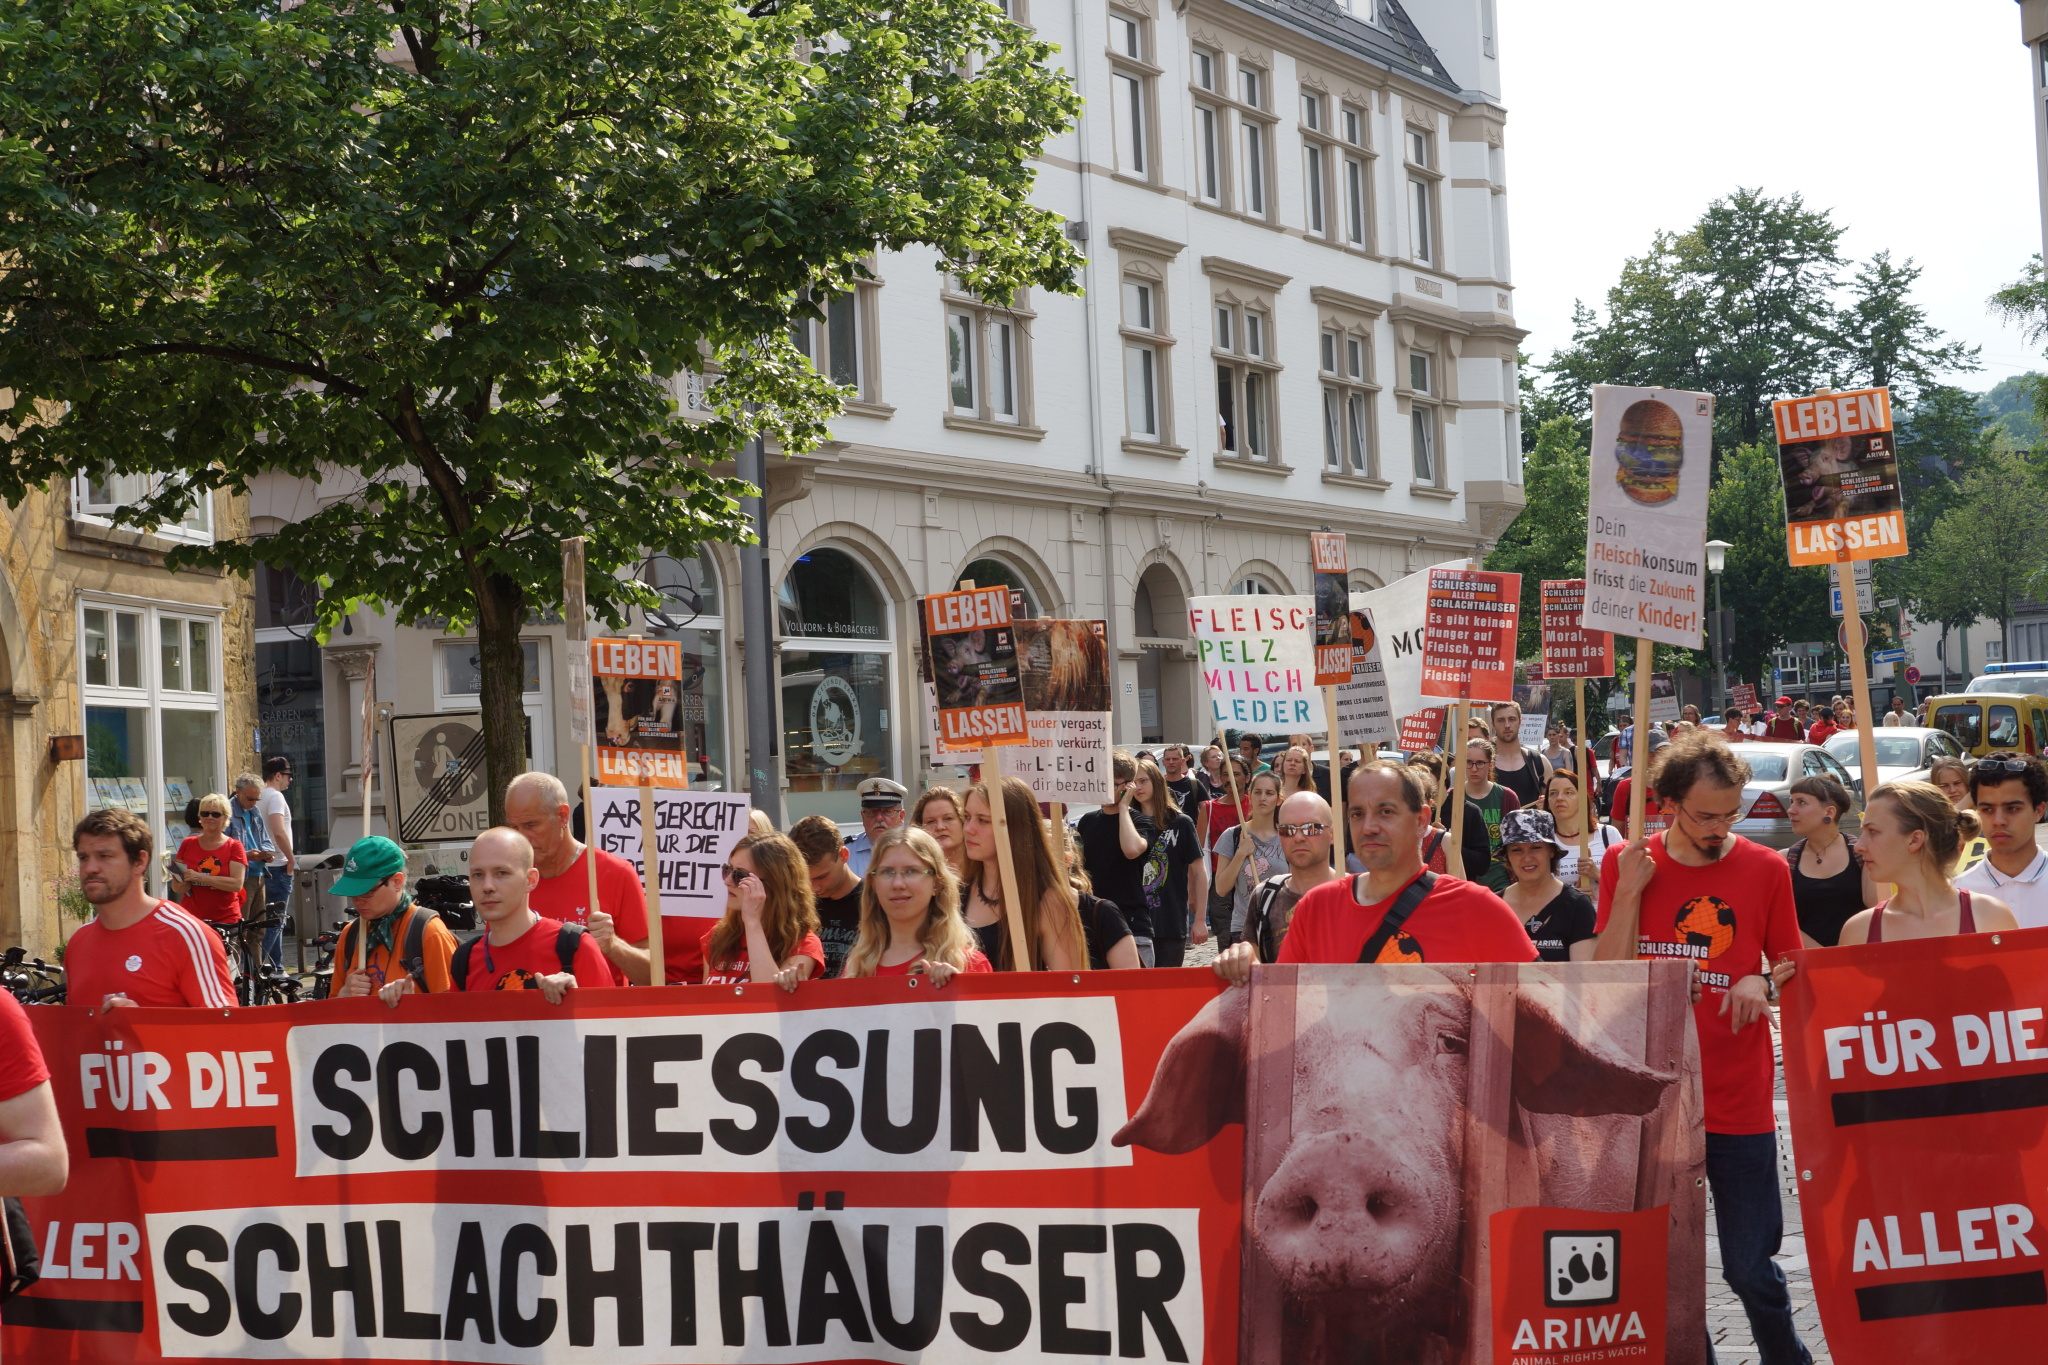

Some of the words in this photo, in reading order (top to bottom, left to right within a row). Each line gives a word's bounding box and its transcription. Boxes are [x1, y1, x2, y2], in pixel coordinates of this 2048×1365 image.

[1780, 393, 1885, 440] LEBEN
[1866, 450, 1890, 459] ARIWA
[1841, 475, 1880, 485] SCHLIESSUNG
[1595, 516, 1626, 537] Dein
[1794, 515, 1900, 554] LASSEN
[1314, 538, 1346, 570] LEBEN
[1594, 542, 1697, 576] Fleischkonsum
[1432, 570, 1447, 579] FÜR
[1449, 571, 1462, 580] DIE
[1432, 580, 1497, 592] SCHLIESSUNG
[1544, 589, 1585, 597] SCHLIESSU
[1592, 569, 1624, 589] frisst
[1628, 575, 1646, 592] die
[1649, 579, 1696, 602] Zukunft
[1452, 591, 1475, 599] ALLER
[932, 590, 1007, 631] LEBEN
[1430, 599, 1516, 613] SCHLACHTHÄUSER
[1544, 603, 1584, 611] SCHLACHT
[1190, 608, 1314, 632] FLEISC
[1429, 613, 1442, 623] Es
[1447, 615, 1469, 626] gibt
[1473, 616, 1512, 628] keinen
[1545, 615, 1570, 626] Erst
[1591, 596, 1634, 620] deiner
[1637, 601, 1696, 632] Kinder!
[827, 622, 833, 633] &
[1428, 627, 1469, 640] Hunger
[1473, 631, 1492, 641] auf
[1545, 630, 1588, 642] Moral,
[1199, 639, 1277, 663] PELZ
[1427, 641, 1473, 655] Fleisch,
[1478, 646, 1497, 656] nur
[1546, 646, 1576, 657] dann
[1583, 645, 1605, 656] das
[596, 643, 676, 677] LEBEN
[1318, 647, 1351, 674] LASSEN
[1426, 656, 1467, 668] Hunger
[1472, 659, 1505, 671] durch
[1546, 661, 1588, 673] Essen!
[1204, 669, 1302, 693] MILCH
[1425, 670, 1471, 682] Fleisch!
[1126, 684, 1132, 693] 55
[1353, 697, 1361, 705] LES
[1213, 699, 1310, 723] LEDER
[1424, 710, 1436, 719] die
[946, 706, 1023, 739] LASSEN
[1027, 717, 1057, 729] ruder
[1061, 718, 1106, 732] vergast,
[1404, 719, 1430, 730] Moral,
[1403, 730, 1423, 739] dann
[1425, 732, 1436, 740] das
[1019, 737, 1053, 748] ben
[1057, 737, 1106, 751] verkürzt,
[602, 750, 683, 778] LASSEN
[1016, 760, 1032, 771] ihr
[1032, 778, 1051, 791] dir
[1056, 778, 1107, 793] bezahlt
[430, 811, 489, 832] ZONE
[599, 799, 745, 831] ARGERECHT
[600, 833, 635, 853] IST
[637, 834, 680, 853] UR
[685, 833, 719, 854] DIE
[1824, 1010, 1942, 1080] FÜR
[1952, 1007, 2048, 1068] DIE
[80, 1040, 172, 1111] FÜR
[187, 1051, 279, 1109] DIE
[311, 1021, 1099, 1161] SCHLIESSUNG
[1853, 1203, 2039, 1272] ALLER
[39, 1221, 142, 1281] LER
[163, 1191, 1189, 1363] SCHLACHTHÄUSER
[1512, 1311, 1646, 1350] ARIWA
[1512, 1357, 1559, 1365] ANIMAL
[1563, 1351, 1604, 1364] RIGHTS
[1608, 1346, 1646, 1358] WATCH
